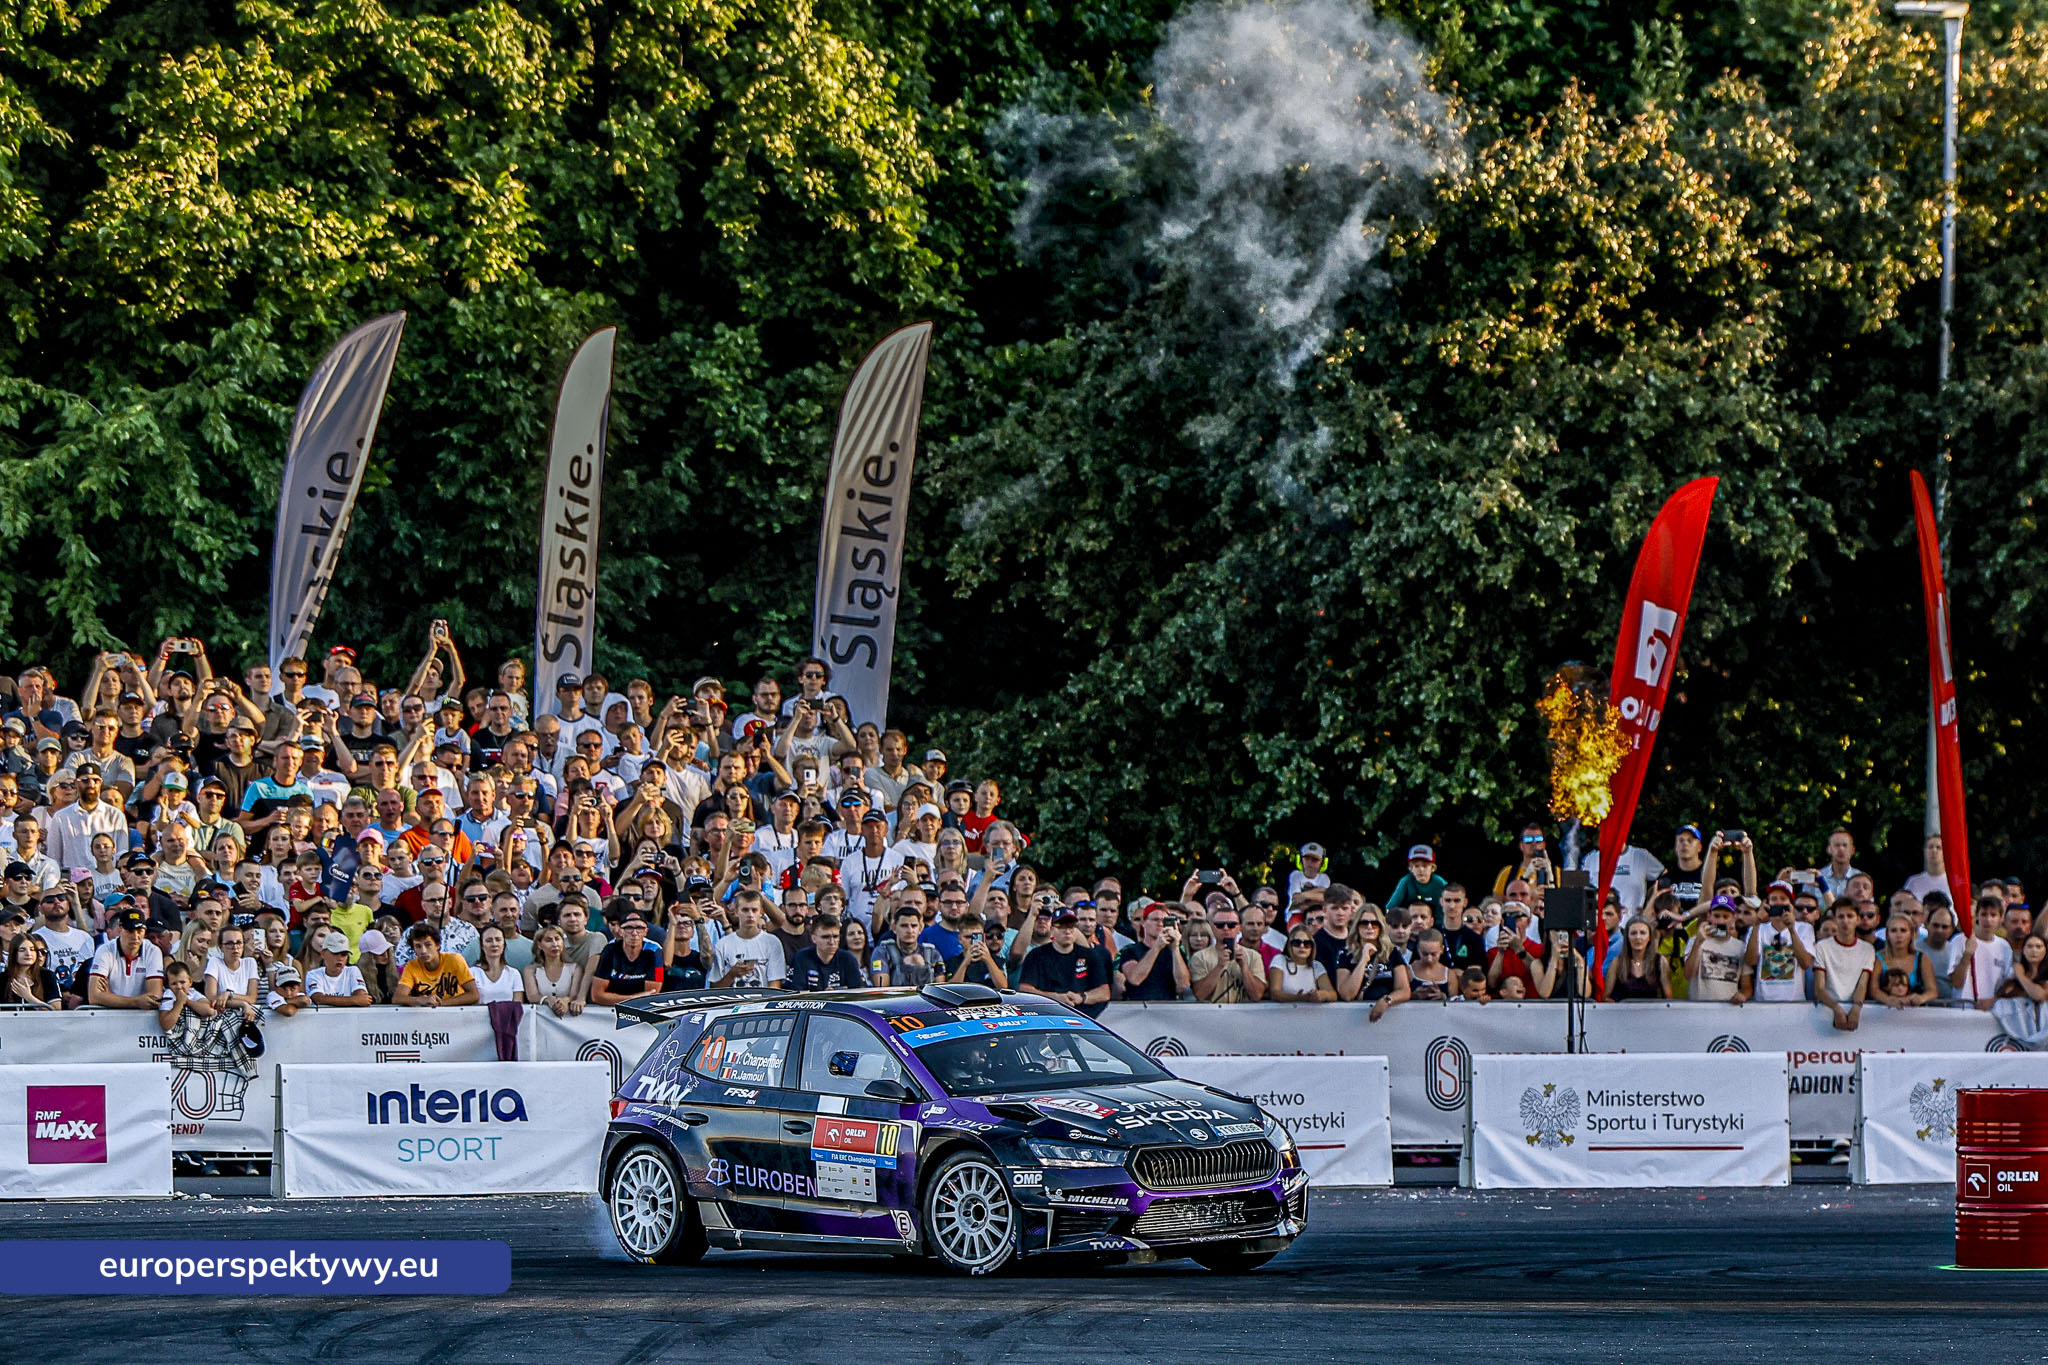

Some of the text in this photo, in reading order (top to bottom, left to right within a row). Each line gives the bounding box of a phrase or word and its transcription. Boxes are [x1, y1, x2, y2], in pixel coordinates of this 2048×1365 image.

[542, 442, 594, 667] Śląskie.
[821, 441, 900, 668] Śląskie.
[774, 1001, 827, 1010] SIMUMOTION
[889, 1015, 926, 1032] 10
[138, 1035, 171, 1049] STAD
[361, 1030, 450, 1049] STADION ŚLĄSKI
[698, 1034, 727, 1073] 10
[742, 1052, 783, 1070] Charpentier
[367, 1083, 529, 1125] interia
[1587, 1090, 1706, 1108] Ministerstwo
[35, 1110, 61, 1121] RMF
[1587, 1113, 1745, 1135] Sportu i Turystyki
[845, 1127, 867, 1138] ORLEN
[880, 1124, 898, 1156] 10
[397, 1136, 503, 1163] SPORT
[847, 1155, 877, 1165] Championship
[1013, 1173, 1043, 1185] OMP
[1996, 1171, 2039, 1183] ORLEN
[1997, 1183, 2014, 1193] OIL
[1067, 1194, 1129, 1206] MICHELIN
